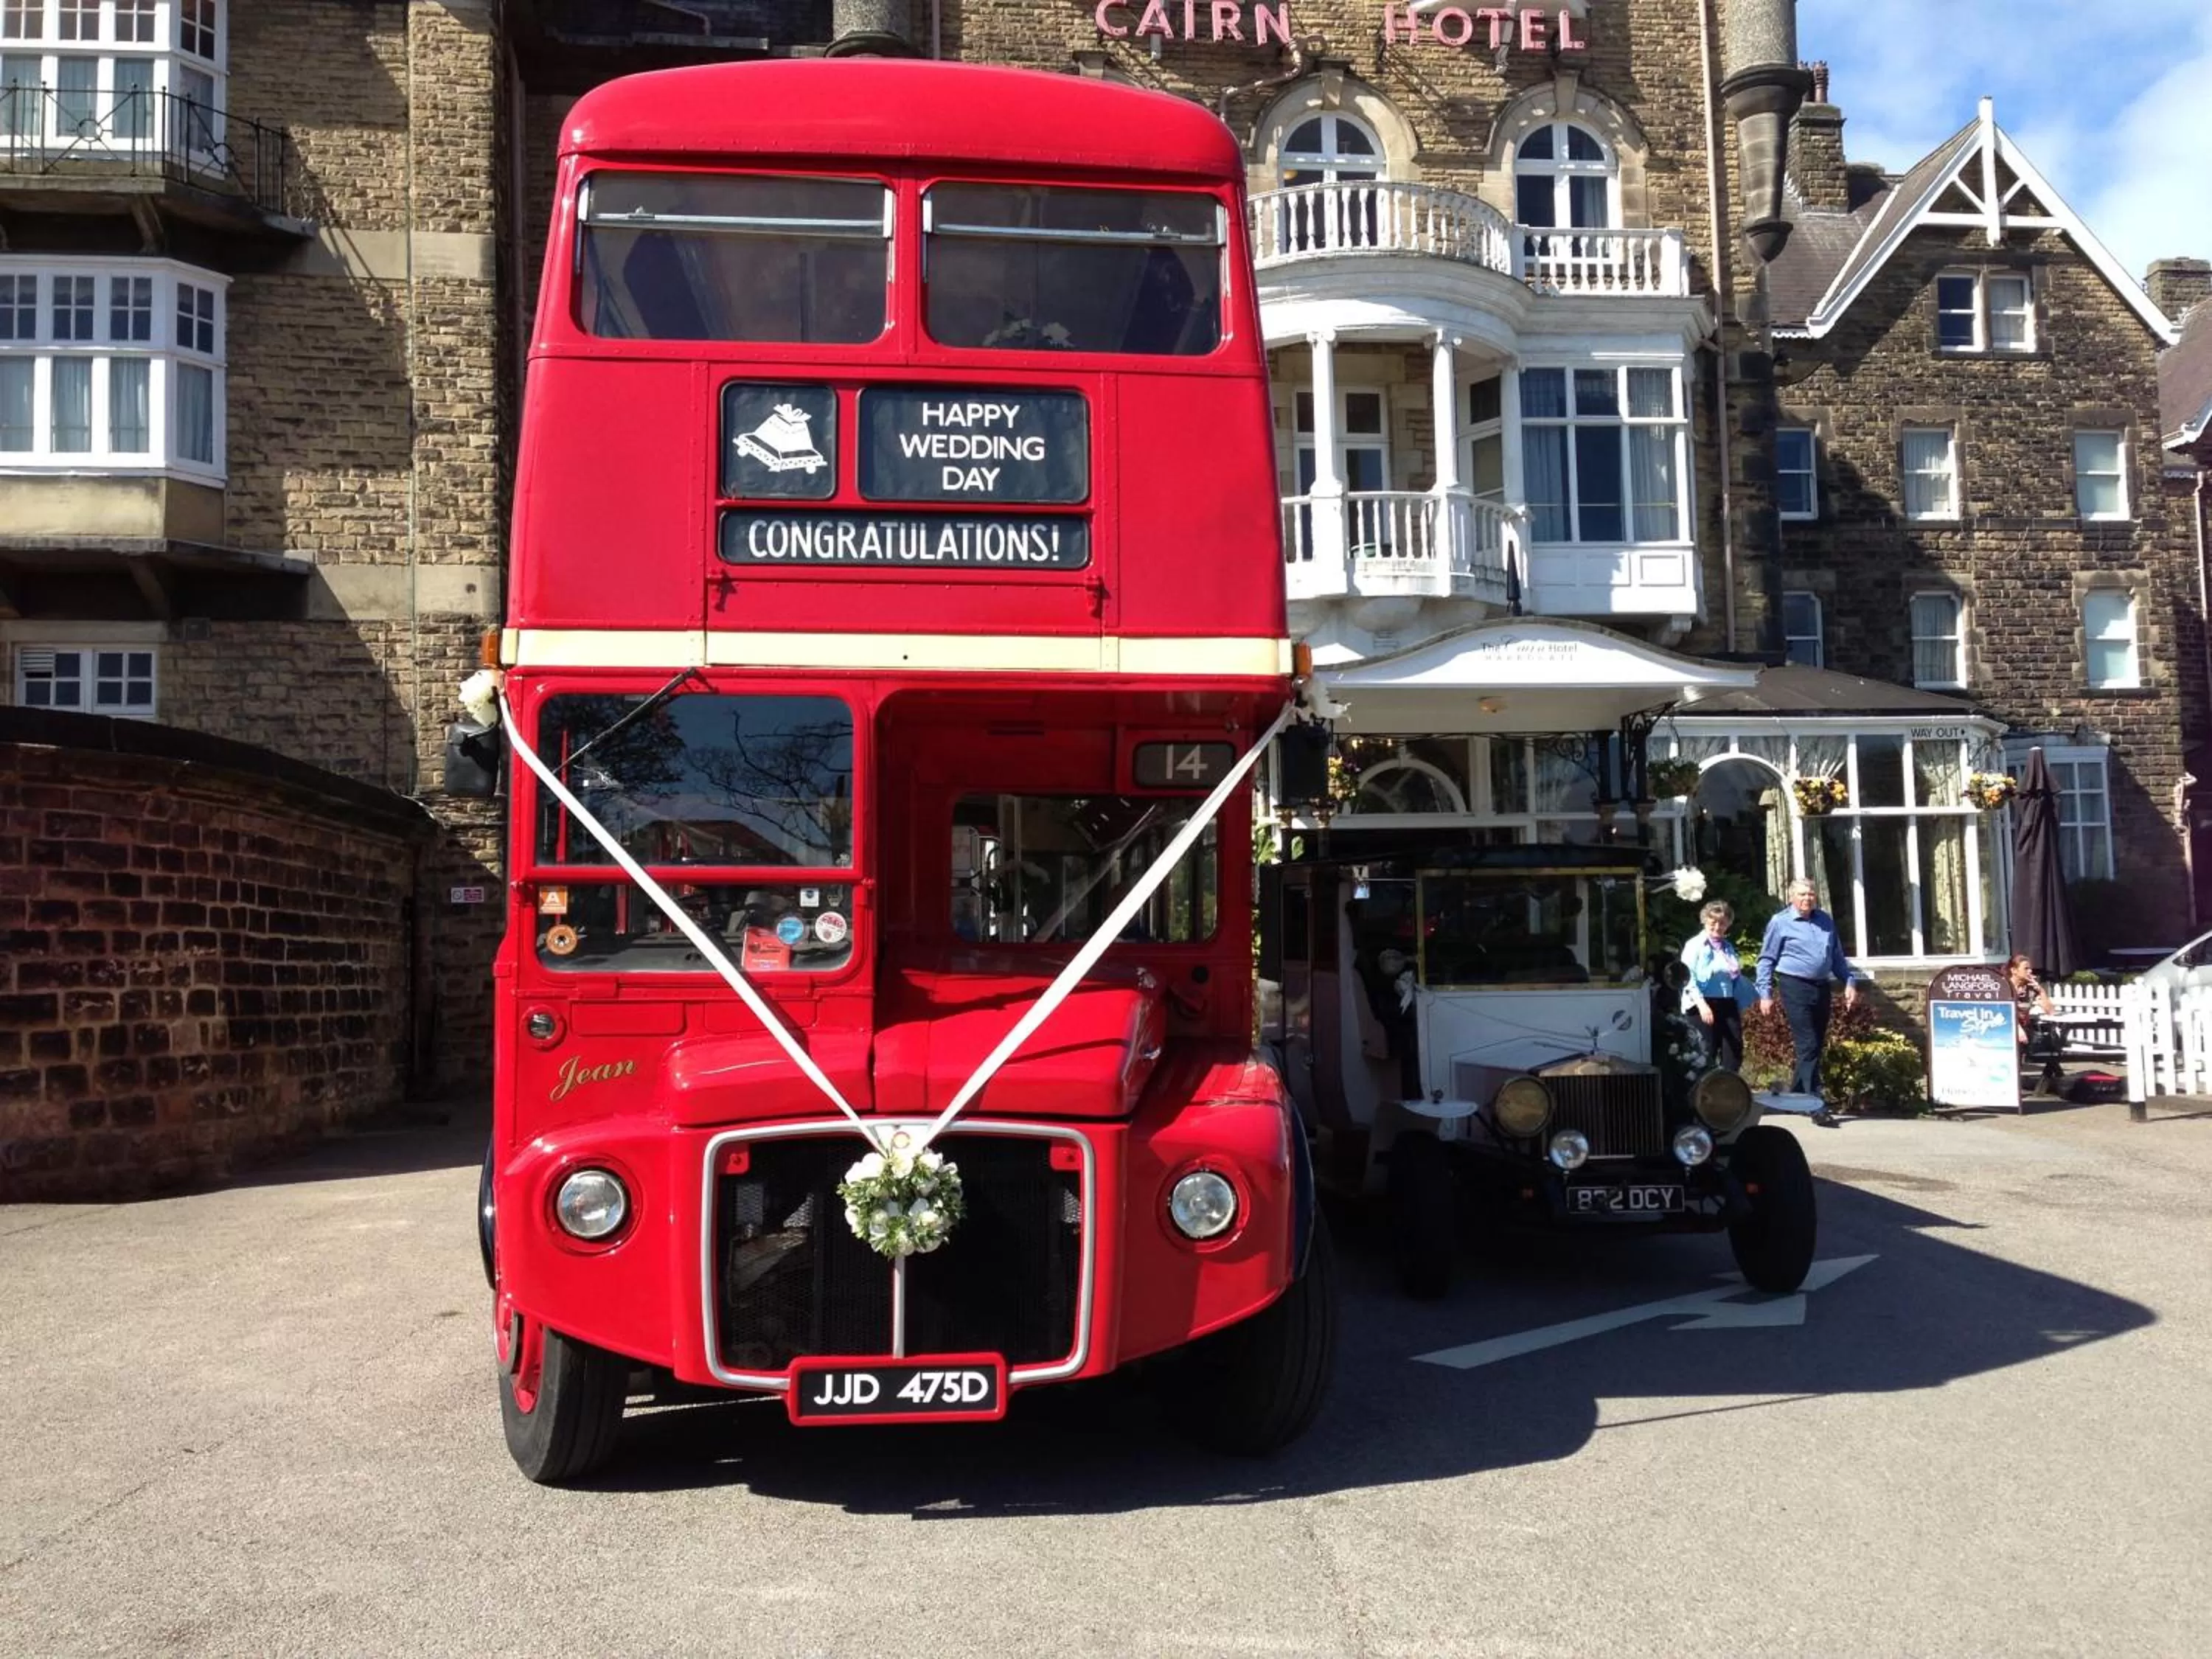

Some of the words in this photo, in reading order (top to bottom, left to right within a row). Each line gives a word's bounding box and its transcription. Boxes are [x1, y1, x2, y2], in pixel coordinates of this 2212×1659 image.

[1094, 0, 1291, 45] CAIRN
[1383, 7, 1586, 50] HOTEL
[922, 403, 1020, 428] HAPPY
[900, 434, 1045, 461] WEDDING
[942, 467, 1001, 491] DAY
[748, 520, 1060, 561] CONGRATULATIONS!
[1911, 728, 1933, 737] WAY
[1935, 728, 1959, 737] OUT
[1166, 743, 1208, 779] 14
[1941, 981, 2000, 992] LANGFORD
[1947, 973, 1994, 982] MICHAEL
[1938, 1006, 1977, 1020] Travel
[549, 1056, 637, 1102] Jean
[1629, 1188, 1674, 1209] DCY
[813, 1374, 880, 1405] JJD
[897, 1371, 989, 1403] 475D
